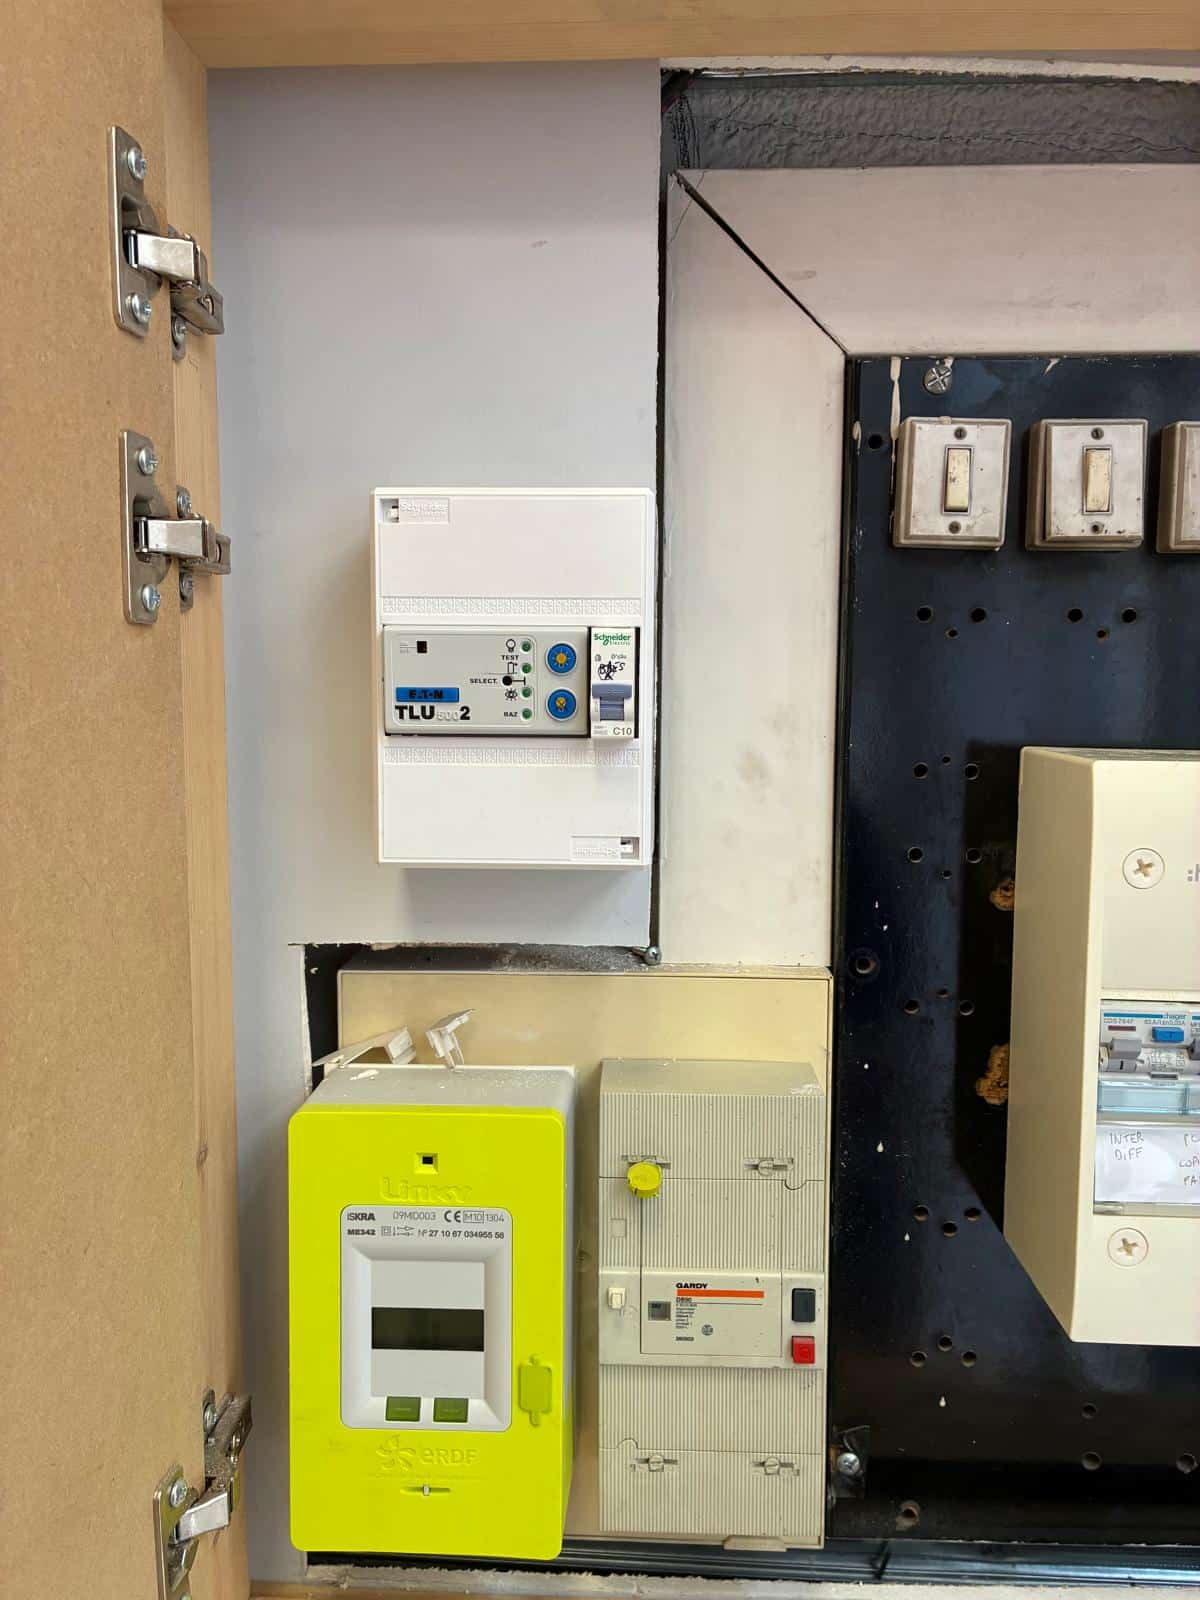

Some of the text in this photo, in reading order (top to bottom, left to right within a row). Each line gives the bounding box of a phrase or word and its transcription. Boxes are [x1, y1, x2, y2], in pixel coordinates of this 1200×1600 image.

[593, 633, 631, 646] Schneider
[612, 727, 633, 736] C10
[1109, 1130, 1145, 1145] INTER
[1114, 1147, 1144, 1161] DIFF
[347, 1212, 376, 1221] ISKRA
[428, 1229, 439, 1238] 27
[441, 1229, 451, 1238] 10
